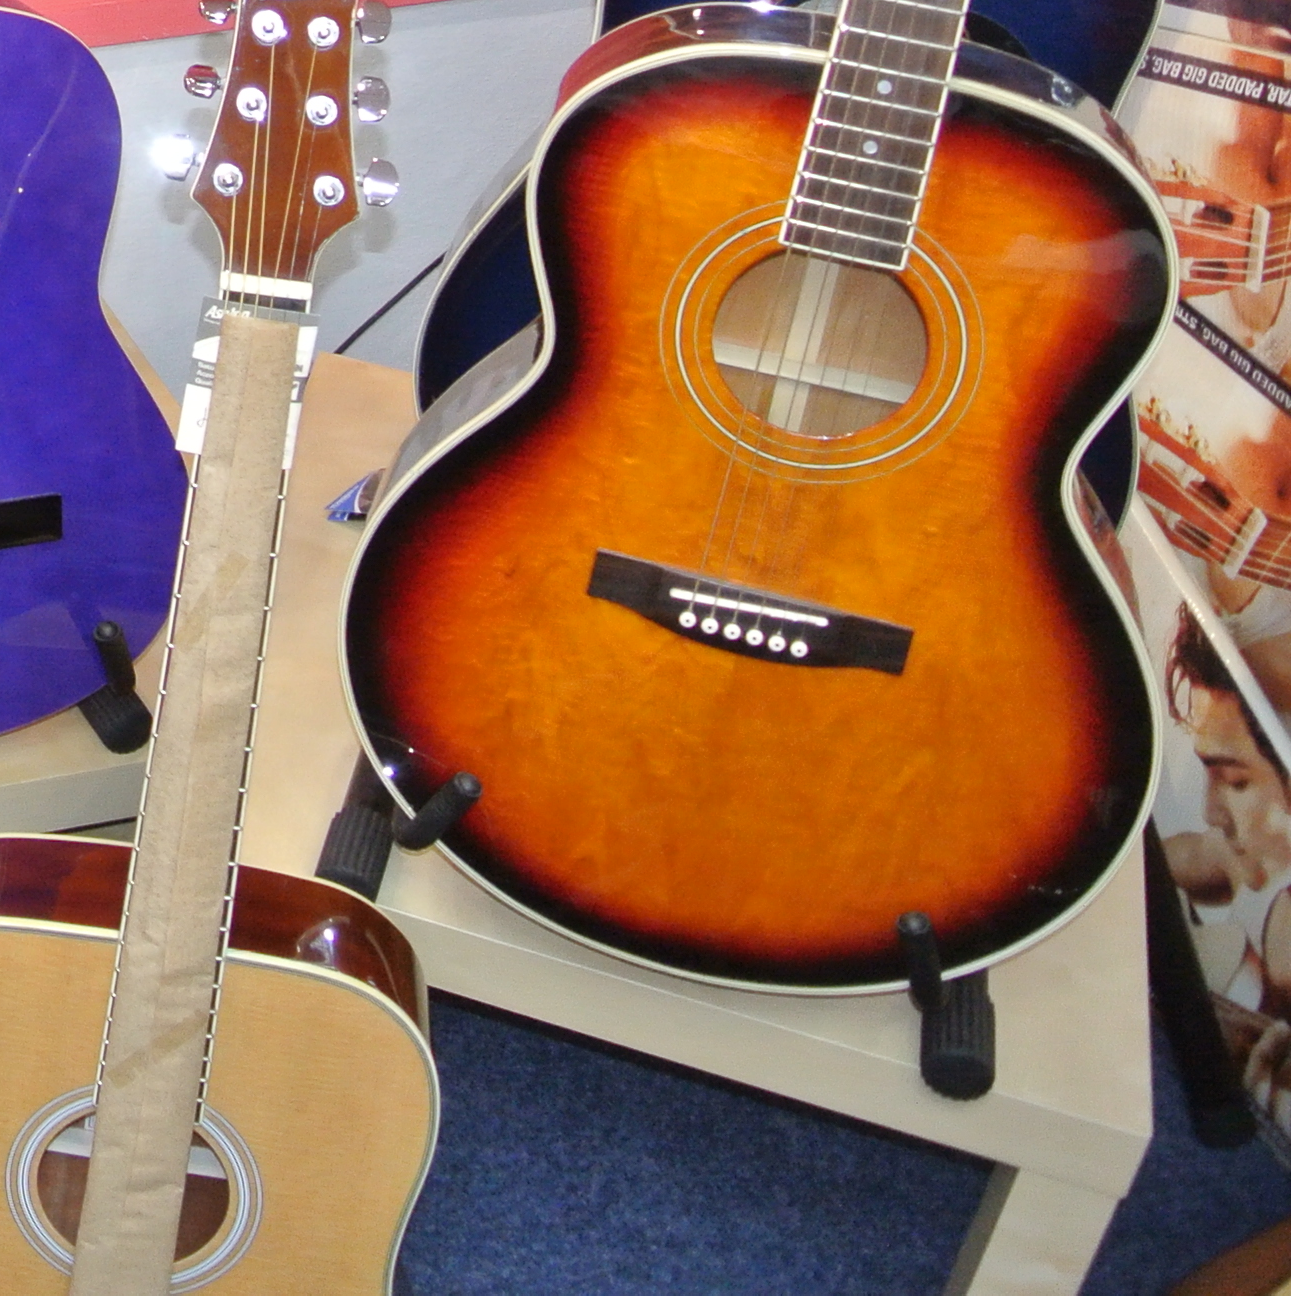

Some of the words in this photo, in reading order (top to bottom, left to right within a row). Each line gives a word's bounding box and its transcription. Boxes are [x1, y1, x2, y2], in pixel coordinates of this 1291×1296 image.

[1152, 54, 1183, 78] BAG,
[1182, 64, 1208, 84] GIG
[1208, 72, 1265, 100] PADDED
